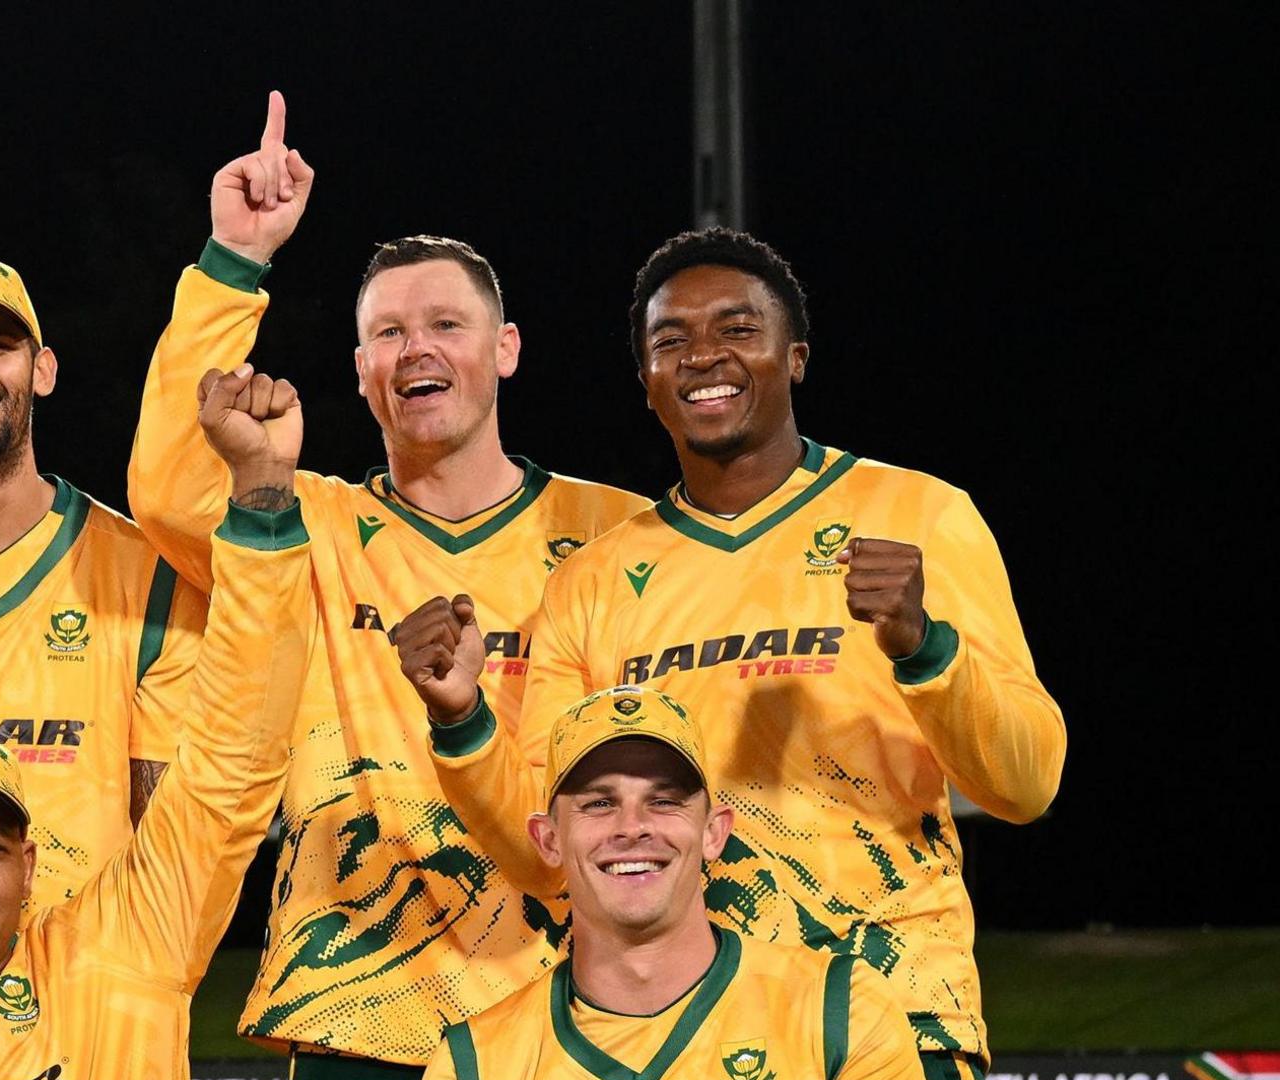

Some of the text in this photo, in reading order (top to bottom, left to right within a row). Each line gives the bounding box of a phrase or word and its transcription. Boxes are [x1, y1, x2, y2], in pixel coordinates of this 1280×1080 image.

[47, 654, 85, 663] PROTEAS
[622, 626, 845, 686] RADAR
[737, 658, 836, 680] TYRES
